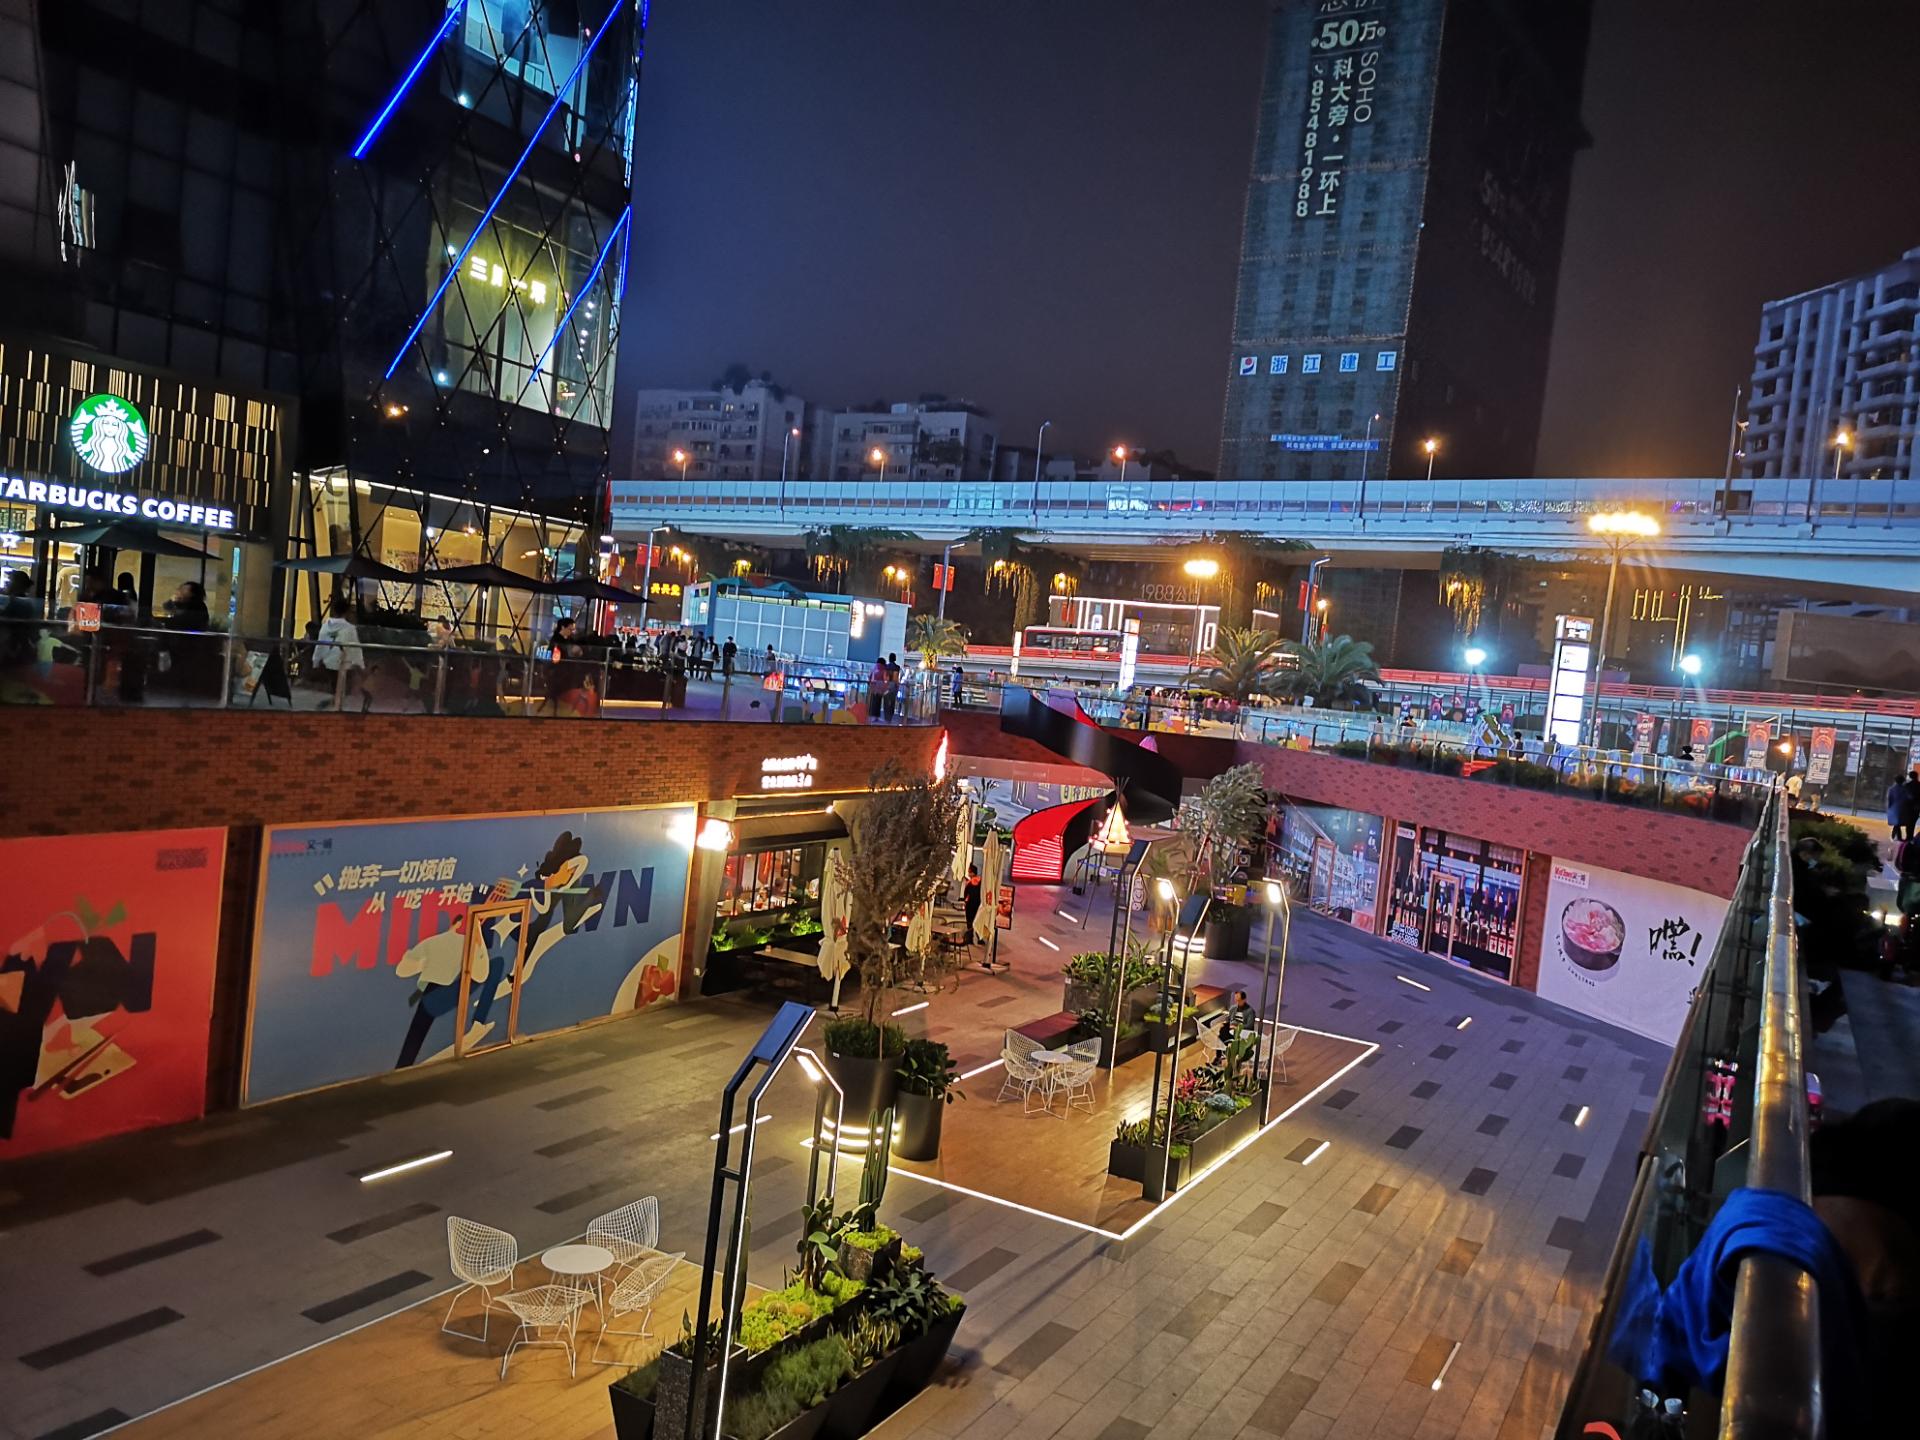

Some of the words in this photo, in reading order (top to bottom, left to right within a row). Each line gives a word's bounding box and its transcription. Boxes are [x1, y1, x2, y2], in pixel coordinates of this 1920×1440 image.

[1353, 51, 1379, 123] SOHO
[1296, 79, 1324, 217] 85481988
[1271, 352, 1397, 374] 浙江建工
[141, 498, 234, 529] COFFEE
